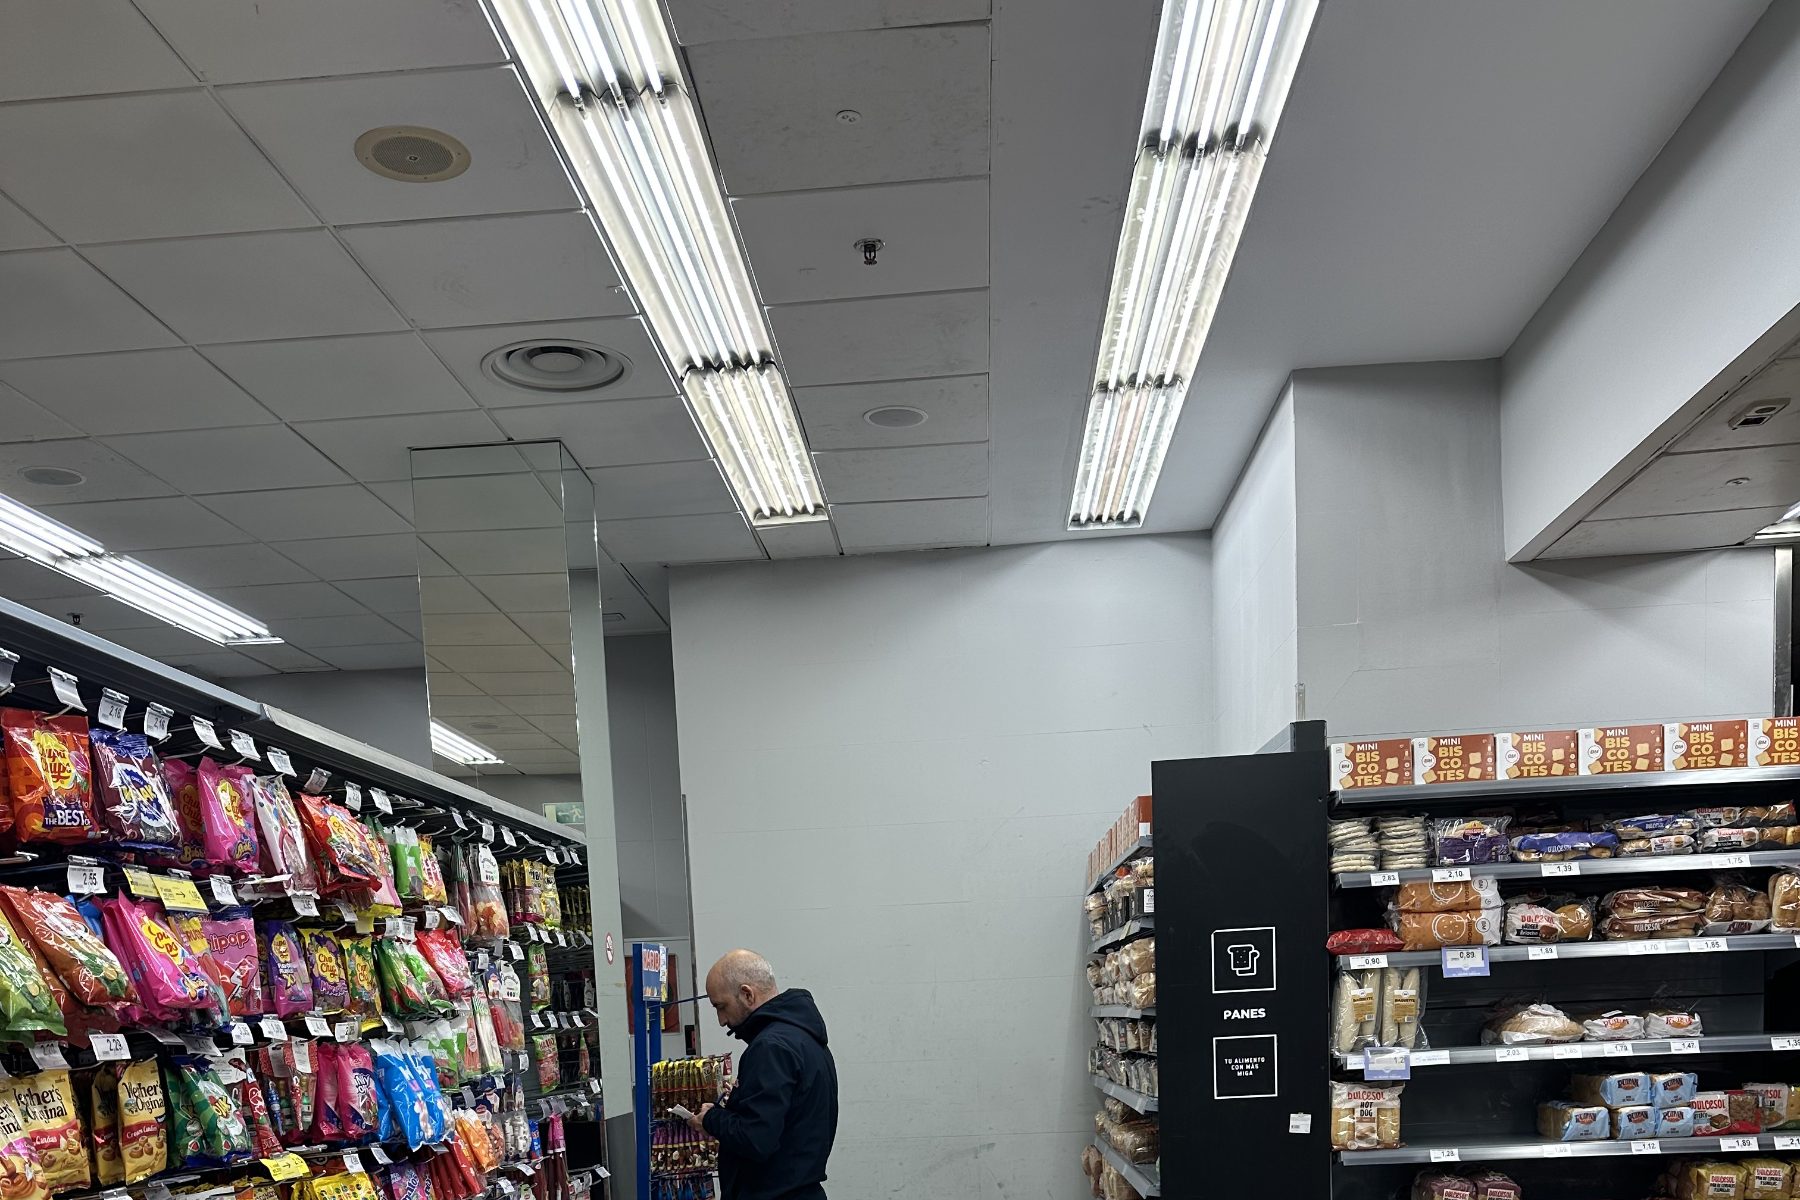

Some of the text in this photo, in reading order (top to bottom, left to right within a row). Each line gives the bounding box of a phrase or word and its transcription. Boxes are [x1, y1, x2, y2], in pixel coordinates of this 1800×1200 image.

[1691, 724, 1713, 732] MINI
[1774, 719, 1797, 728] MINI
[1523, 733, 1544, 742] MINI
[1606, 728, 1628, 737] MINI
[1690, 732, 1715, 743] BIS
[1773, 728, 1799, 739] BIS
[1357, 743, 1378, 751] MINI
[1440, 737, 1461, 746] MINI
[1605, 737, 1631, 748] BIS
[1775, 740, 1796, 751] CO
[1438, 746, 1463, 757] BIS
[1522, 742, 1546, 753] BIS
[1691, 744, 1713, 755] CO
[1355, 751, 1380, 762] BIS
[1523, 754, 1545, 765] CO
[1606, 749, 1629, 760] CO
[1771, 752, 1800, 763] TES
[1440, 758, 1462, 769] CO
[1604, 761, 1632, 772] TES
[1688, 756, 1716, 768] TES
[1357, 764, 1379, 774] CO
[1521, 765, 1548, 777] TES
[1437, 769, 1465, 781] TES
[1355, 775, 1382, 787] TES
[57, 810, 84, 826] BEST
[1223, 1008, 1266, 1020] PANES
[1348, 1091, 1385, 1100] DULCESOL
[1360, 1101, 1373, 1109] HOT
[1692, 1099, 1726, 1110] DULCESOL
[1360, 1109, 1373, 1117] DOG
